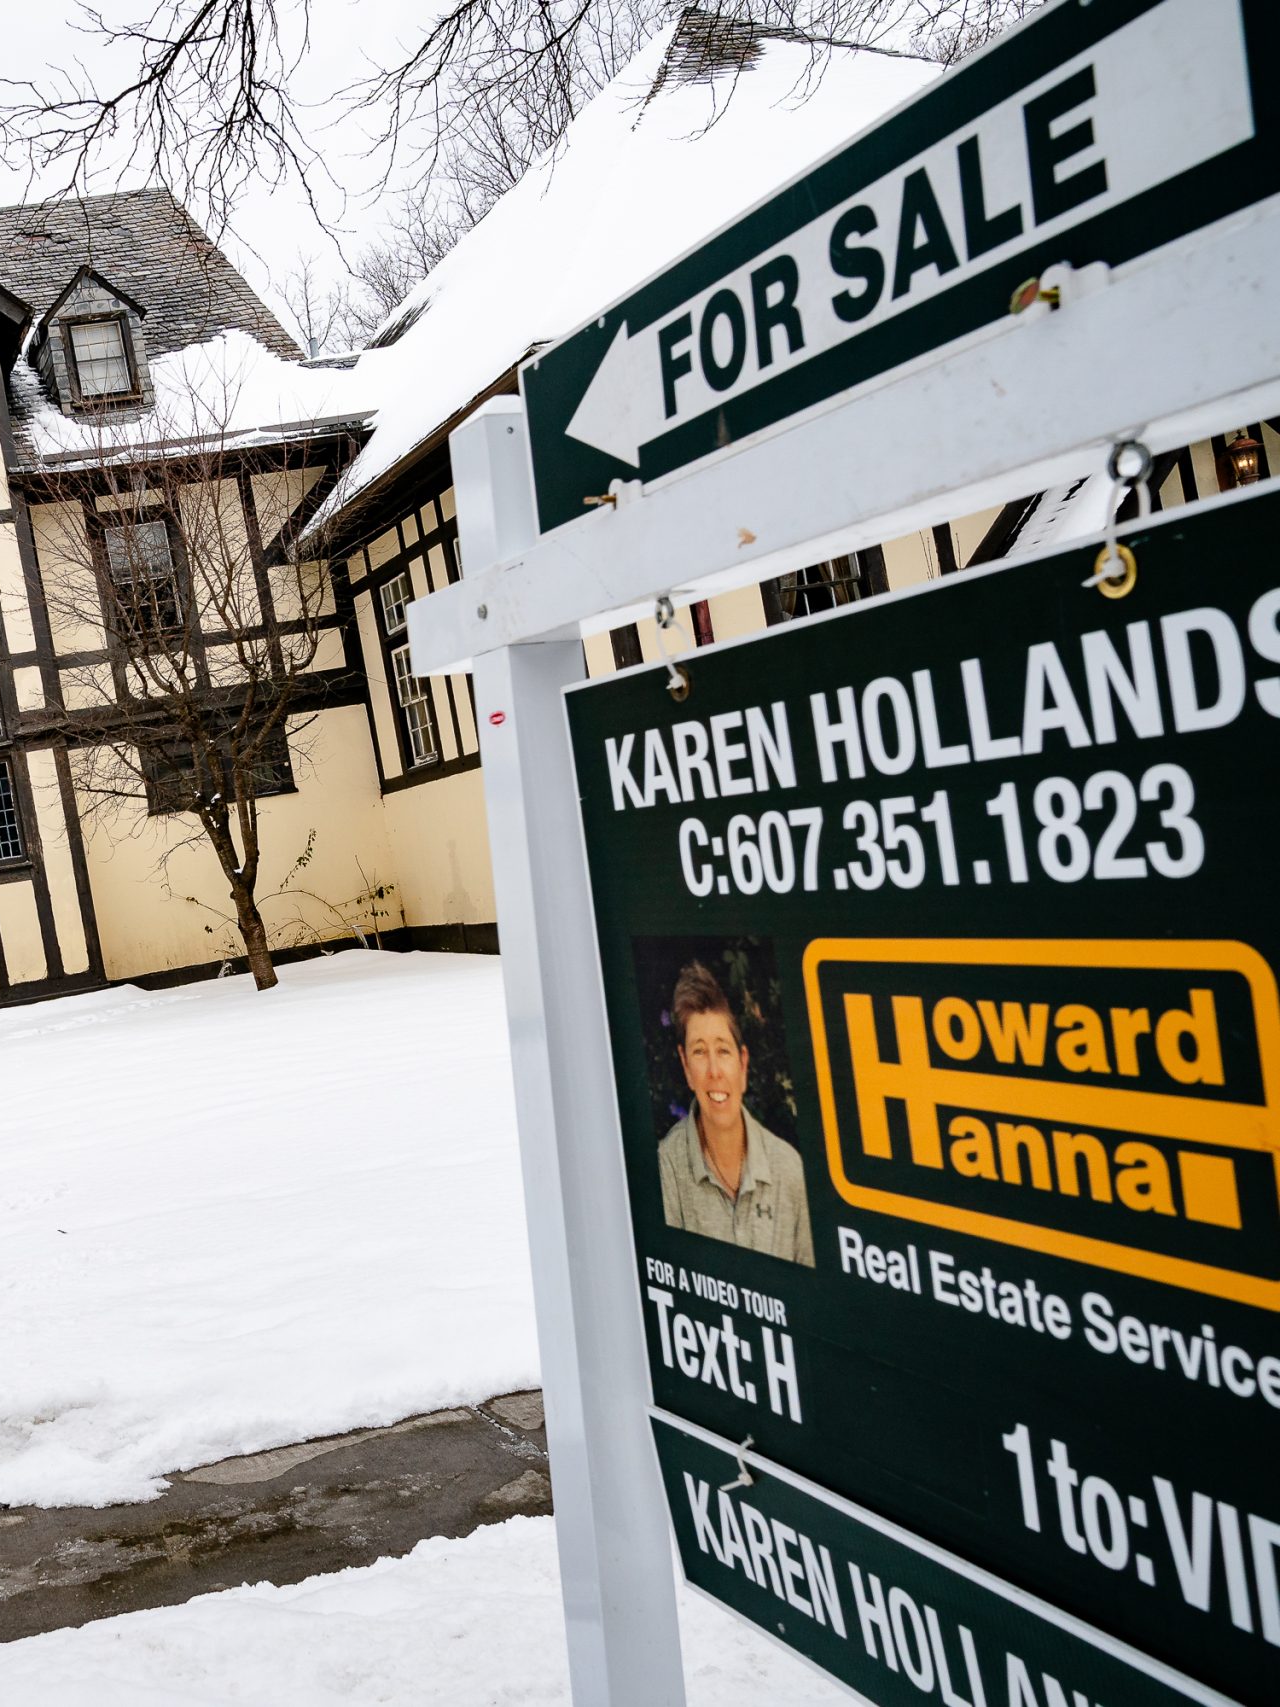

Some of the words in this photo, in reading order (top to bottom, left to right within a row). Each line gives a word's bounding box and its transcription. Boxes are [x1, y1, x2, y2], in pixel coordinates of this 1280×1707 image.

[659, 254, 807, 420] FOR
[829, 63, 1109, 324] SALE
[605, 701, 798, 812] KAREN
[678, 763, 1206, 898] C:607.351.1823
[843, 988, 1226, 1115] Howard
[843, 1072, 1178, 1218] Hanna
[645, 1256, 676, 1288] FOR
[678, 1267, 691, 1293] A
[691, 1271, 739, 1310] VIDEO
[740, 1288, 788, 1327] TOUR
[837, 1225, 922, 1295] Real
[928, 1250, 1072, 1340] Estate
[647, 1285, 758, 1405] Text:
[761, 1325, 803, 1425] H
[682, 1470, 848, 1640] KAREN
